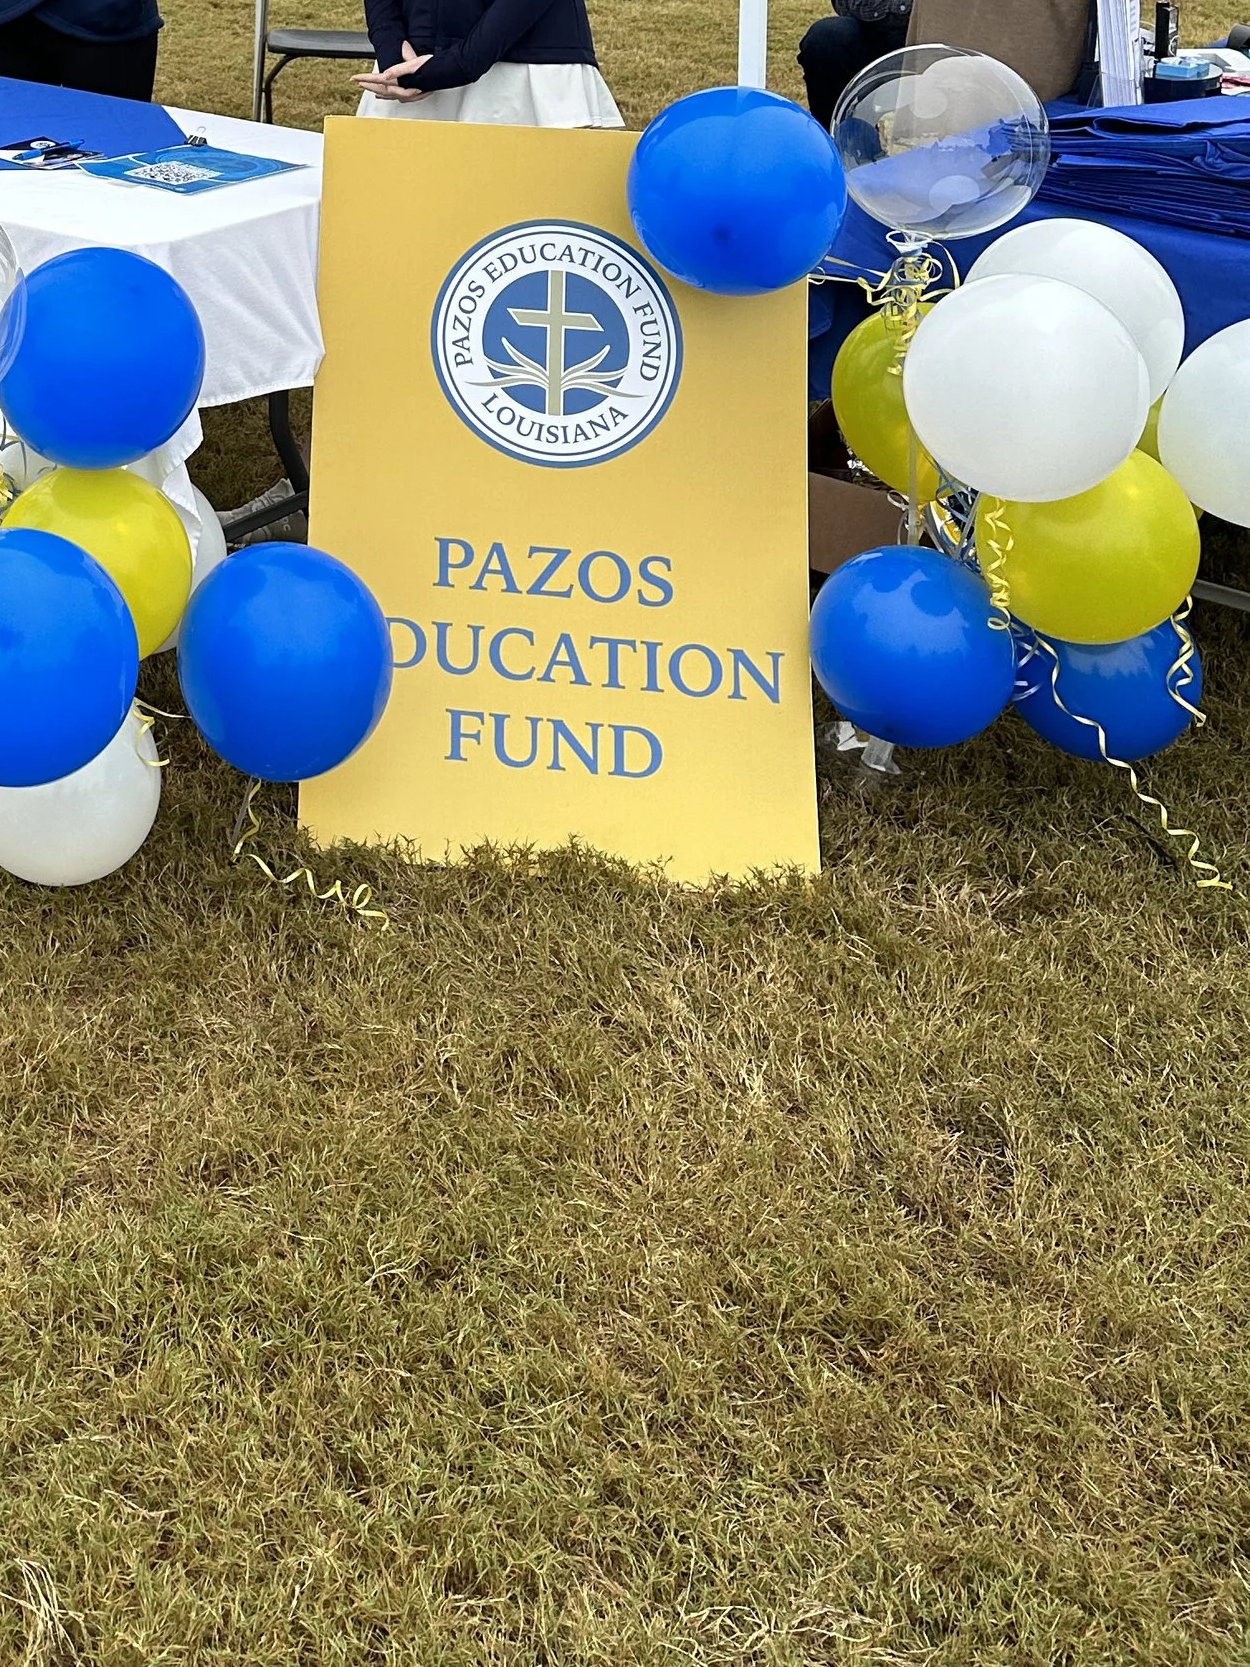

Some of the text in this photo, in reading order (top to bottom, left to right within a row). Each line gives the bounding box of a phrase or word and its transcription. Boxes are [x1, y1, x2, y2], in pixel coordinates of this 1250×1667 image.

[451, 242, 662, 382] PAZOS EDUCATION FUND
[481, 392, 629, 444] LOUISIANA
[433, 536, 674, 607] PAZOS
[385, 616, 785, 704] DUCATION
[444, 708, 664, 779] FUND
